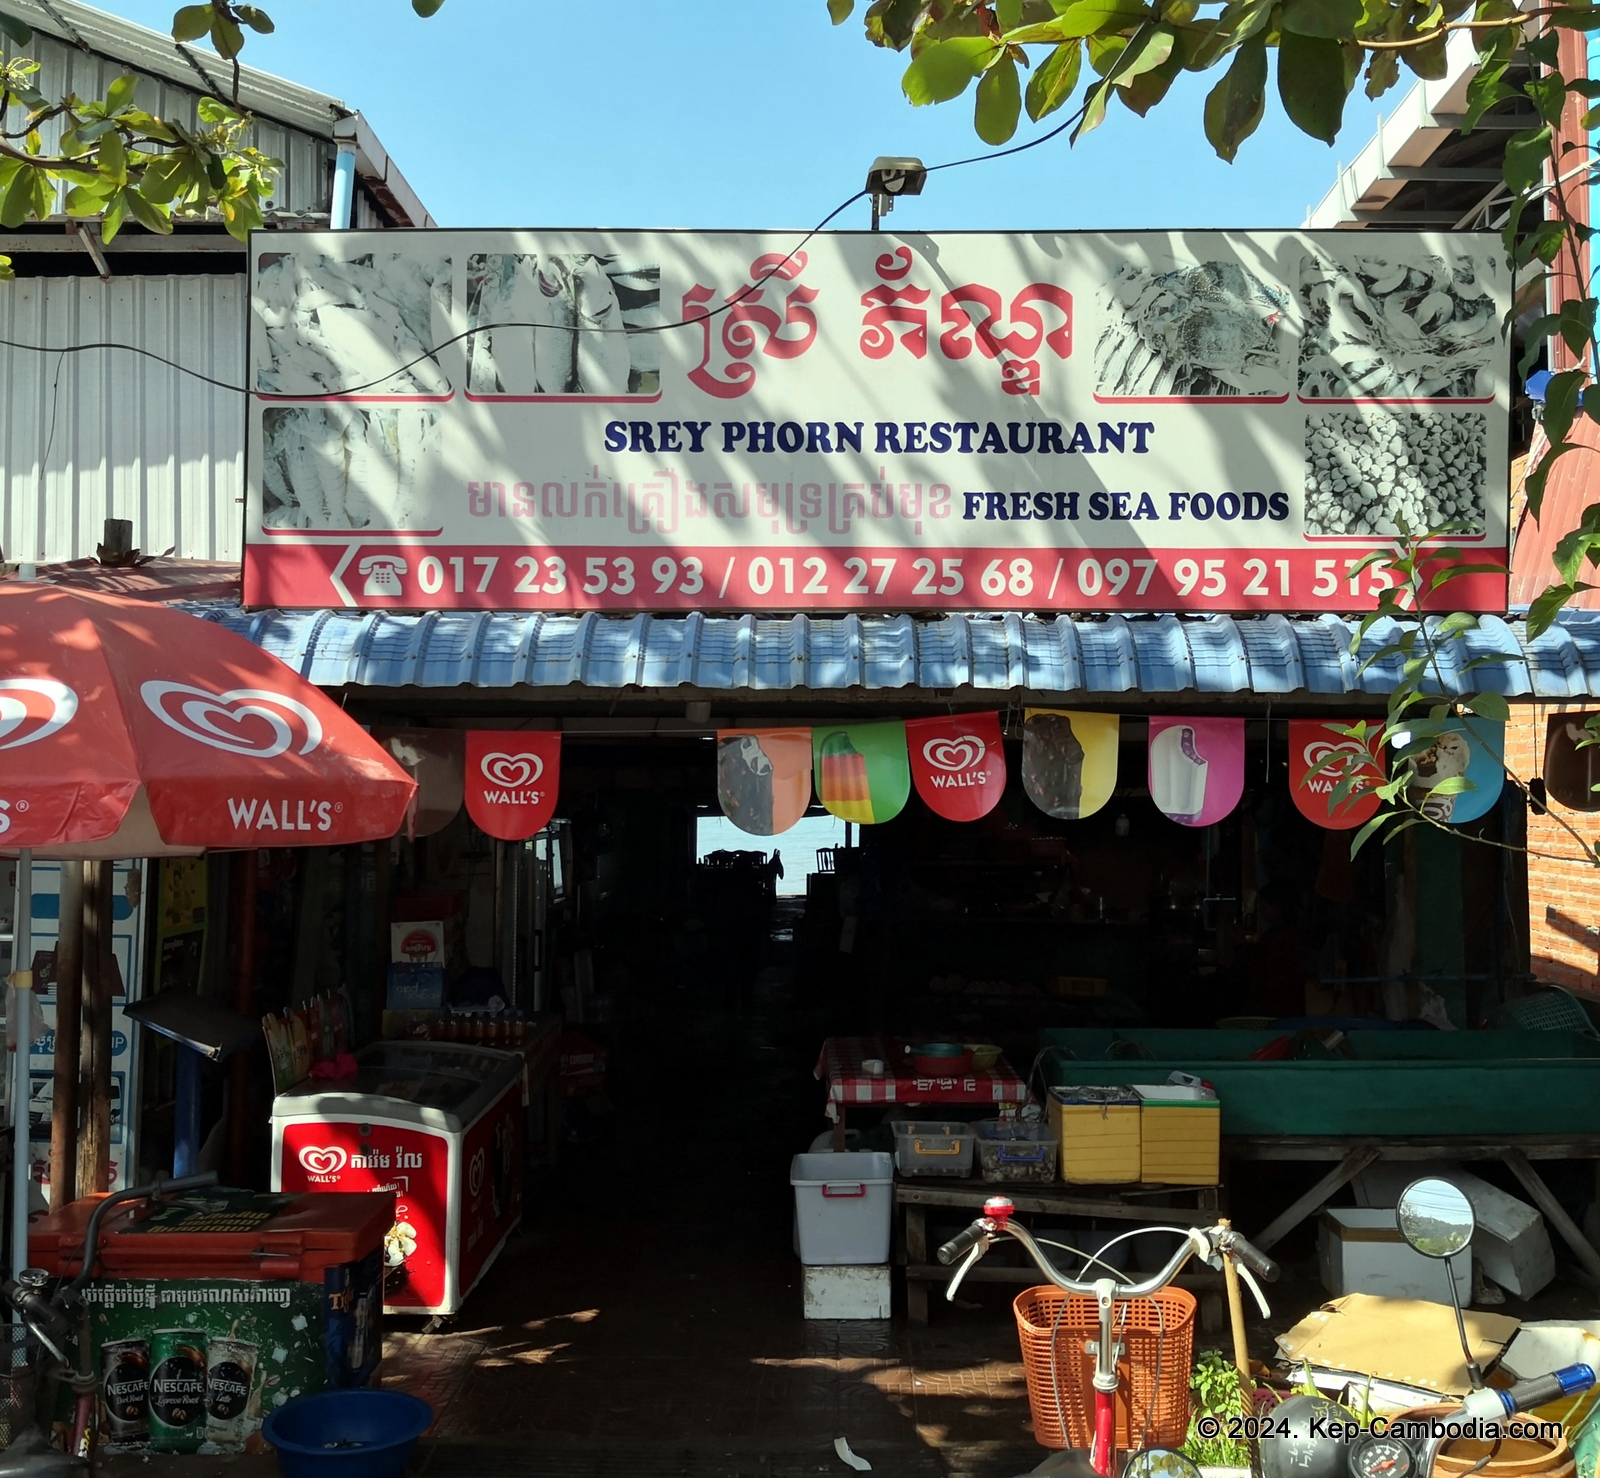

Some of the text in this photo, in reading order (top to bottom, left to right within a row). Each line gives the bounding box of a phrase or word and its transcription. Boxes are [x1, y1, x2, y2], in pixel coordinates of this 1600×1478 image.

[682, 250, 821, 400] ស្រី
[605, 421, 1155, 454] SREY PHORN RESTAURANT
[963, 492, 1288, 521] FRESH SEA FOODS
[418, 555, 499, 594] 017
[514, 555, 567, 595] 23
[583, 556, 635, 596] 53
[652, 556, 704, 597] 93
[748, 556, 828, 597] 012
[843, 557, 898, 596] 27
[912, 557, 964, 597] 25
[980, 557, 1034, 597] 68
[1077, 558, 1160, 598] 097
[1173, 558, 1227, 598] 95
[1242, 558, 1291, 597] 21
[1312, 558, 1394, 598] 515
